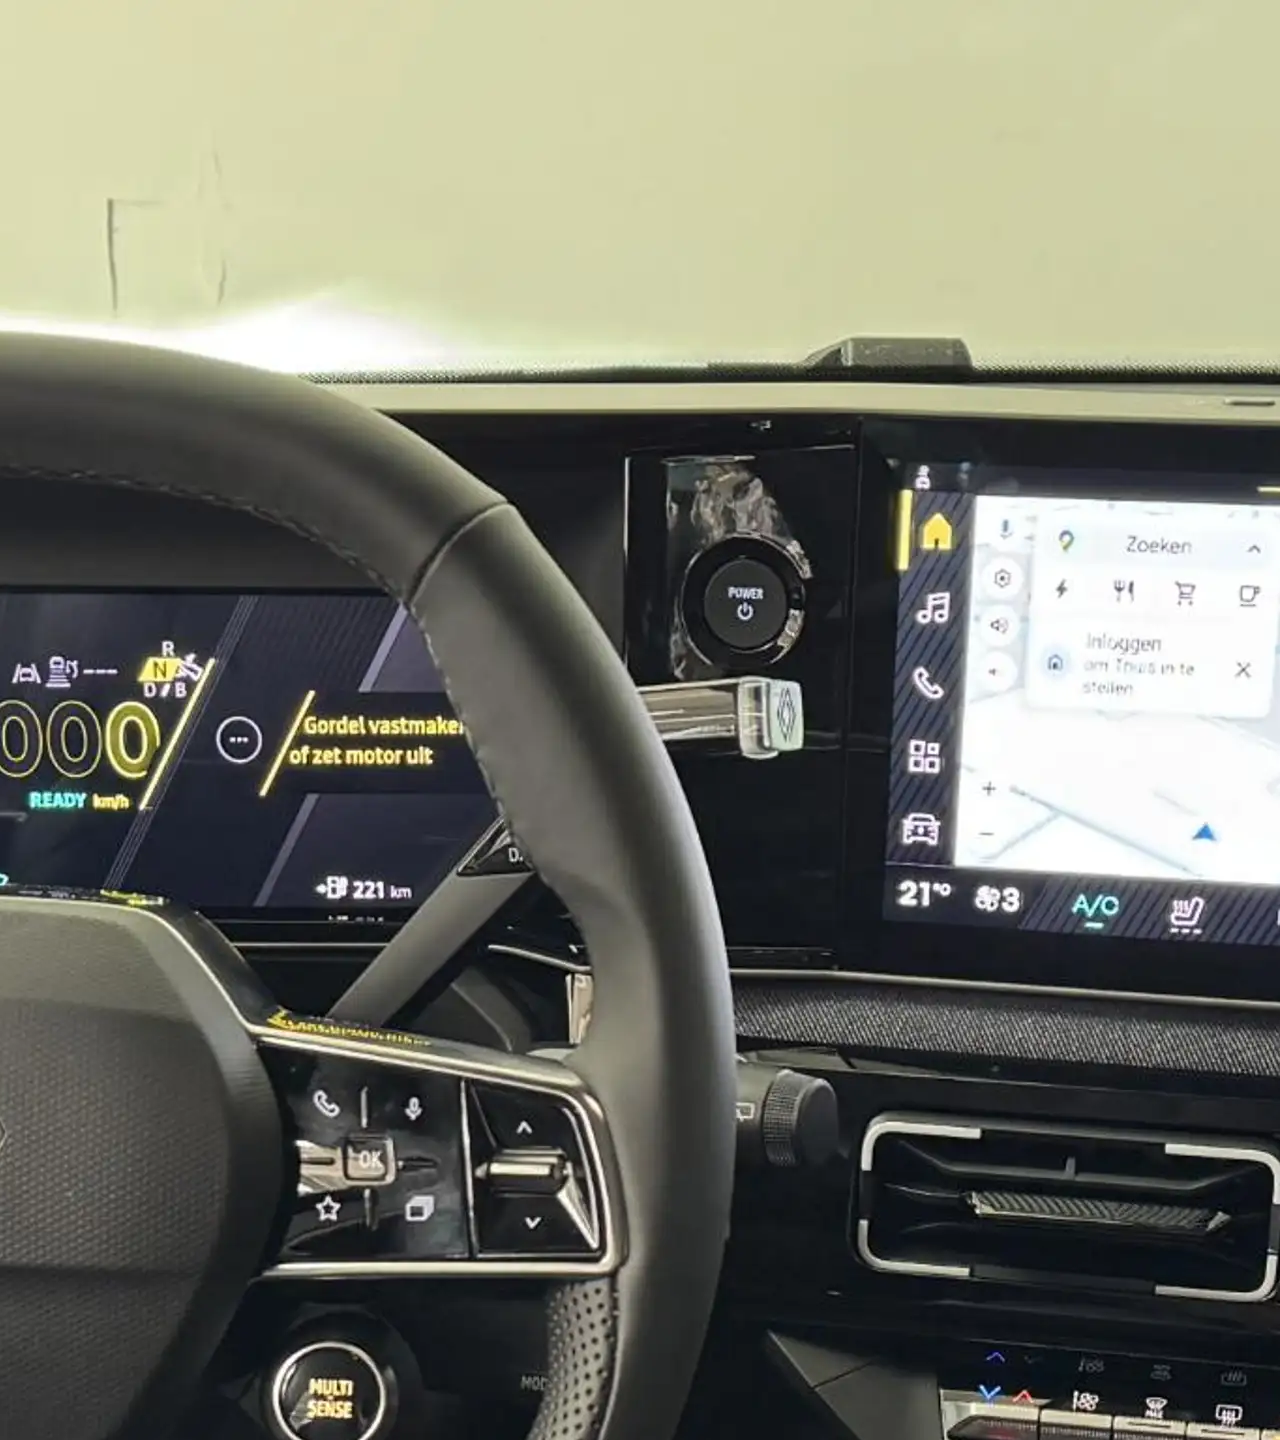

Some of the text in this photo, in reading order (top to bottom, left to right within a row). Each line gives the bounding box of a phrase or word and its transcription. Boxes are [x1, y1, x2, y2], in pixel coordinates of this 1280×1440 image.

[1125, 535, 1193, 555] Zoeken
[727, 586, 764, 600] POWER
[162, 640, 175, 657] R
[1085, 632, 1162, 656] Inloggen
[152, 661, 167, 677] N
[1083, 660, 1109, 673] om
[304, 716, 366, 735] Gordel
[289, 745, 434, 765] of zet motor uit
[28, 791, 130, 810] READY km/h
[352, 881, 412, 900] 221 km
[1001, 886, 1021, 912] 3
[1070, 893, 1120, 917] A/C
[359, 1149, 384, 1169] OK
[308, 1377, 354, 1397] MULTI
[306, 1399, 353, 1419] SENSE
